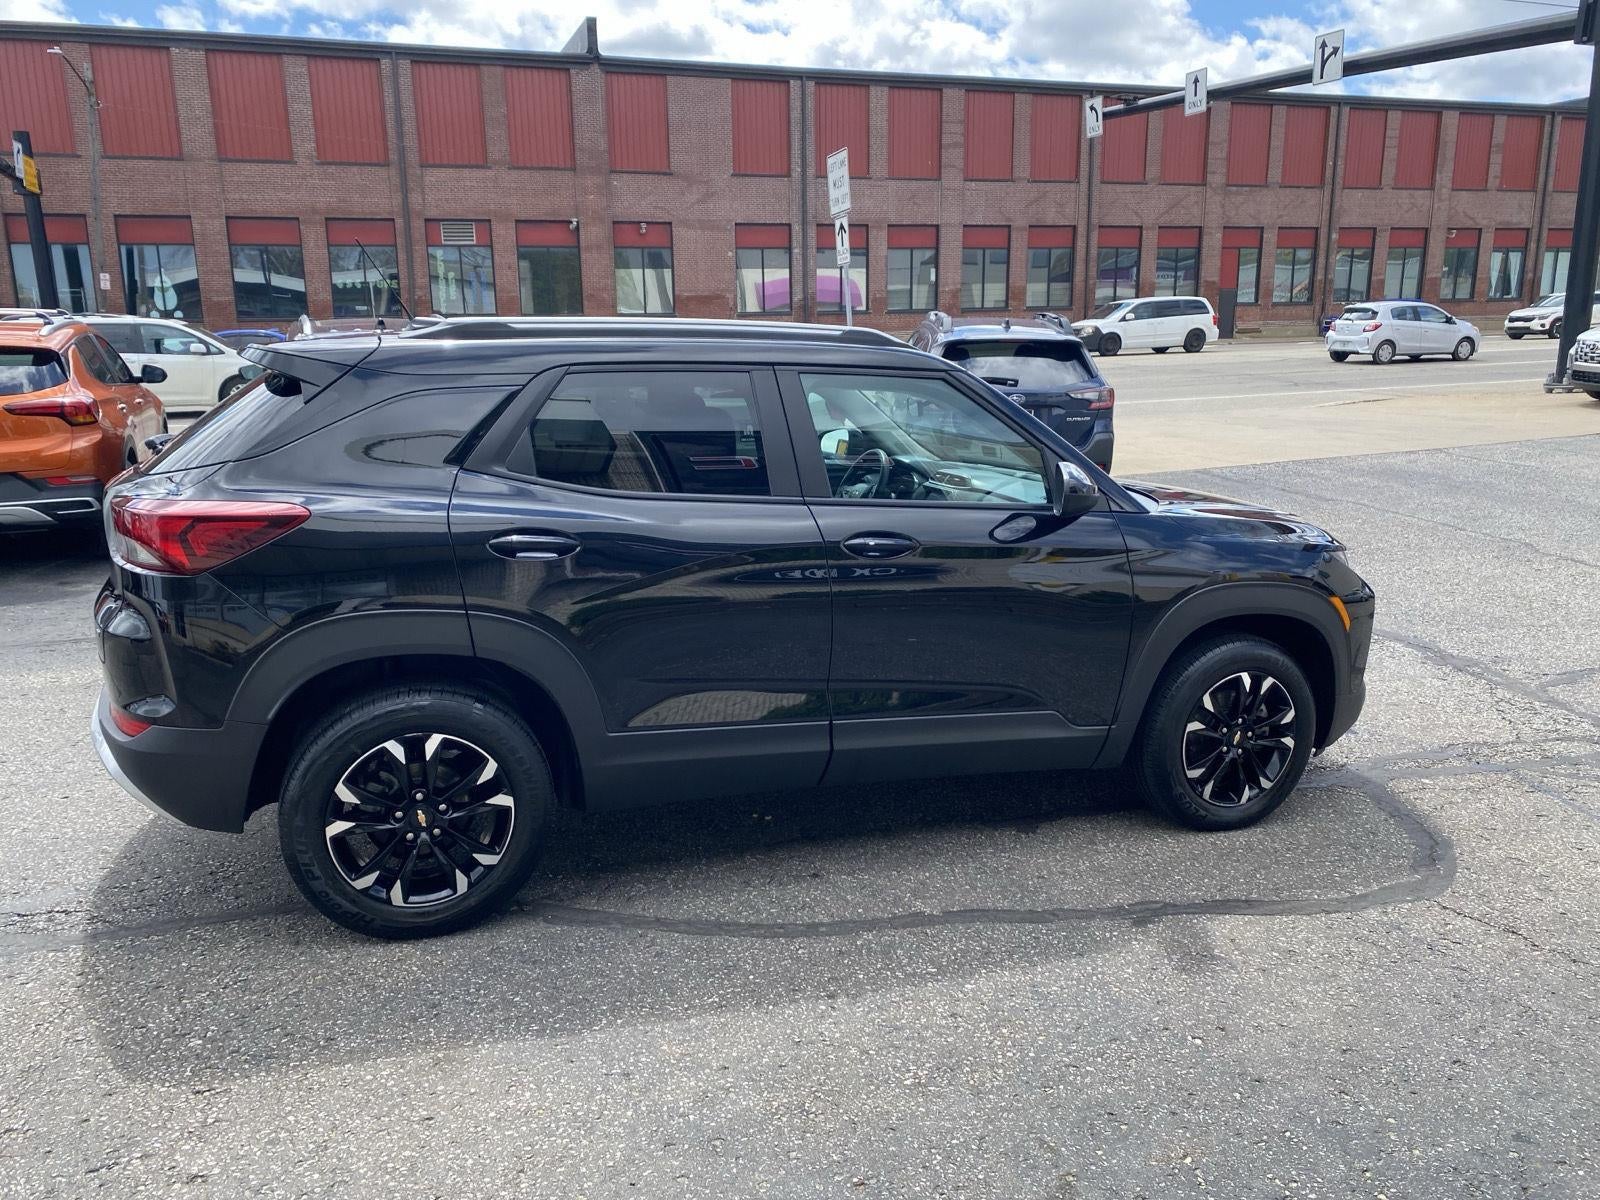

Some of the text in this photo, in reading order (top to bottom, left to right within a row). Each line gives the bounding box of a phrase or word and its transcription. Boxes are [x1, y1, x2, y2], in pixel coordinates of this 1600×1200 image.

[1188, 98, 1202, 109] ONLY
[1088, 123, 1101, 134] ONLY
[832, 175, 845, 189] MUST
